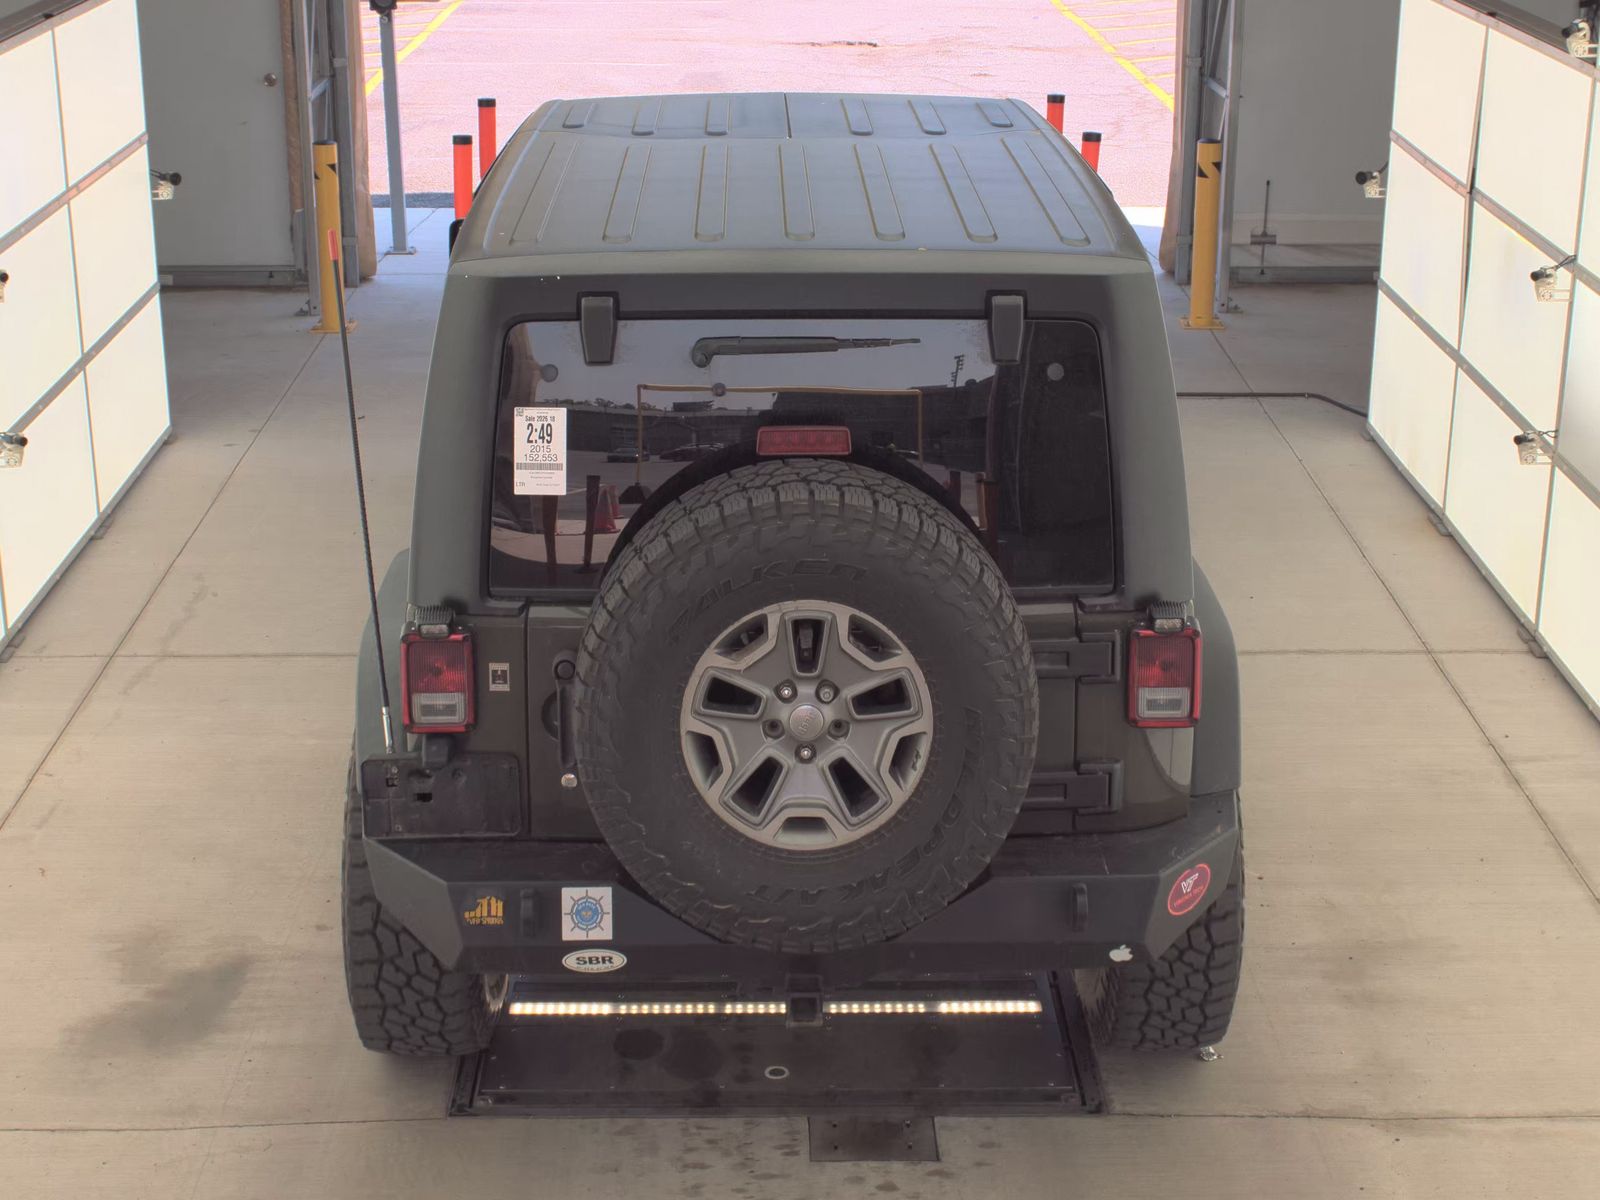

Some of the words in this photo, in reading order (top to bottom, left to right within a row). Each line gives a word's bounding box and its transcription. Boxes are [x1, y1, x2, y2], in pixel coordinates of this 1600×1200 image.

[527, 422, 553, 444] 2:49
[530, 445, 552, 453] 2015
[524, 453, 558, 462] 152,553
[575, 955, 615, 966] SBR
